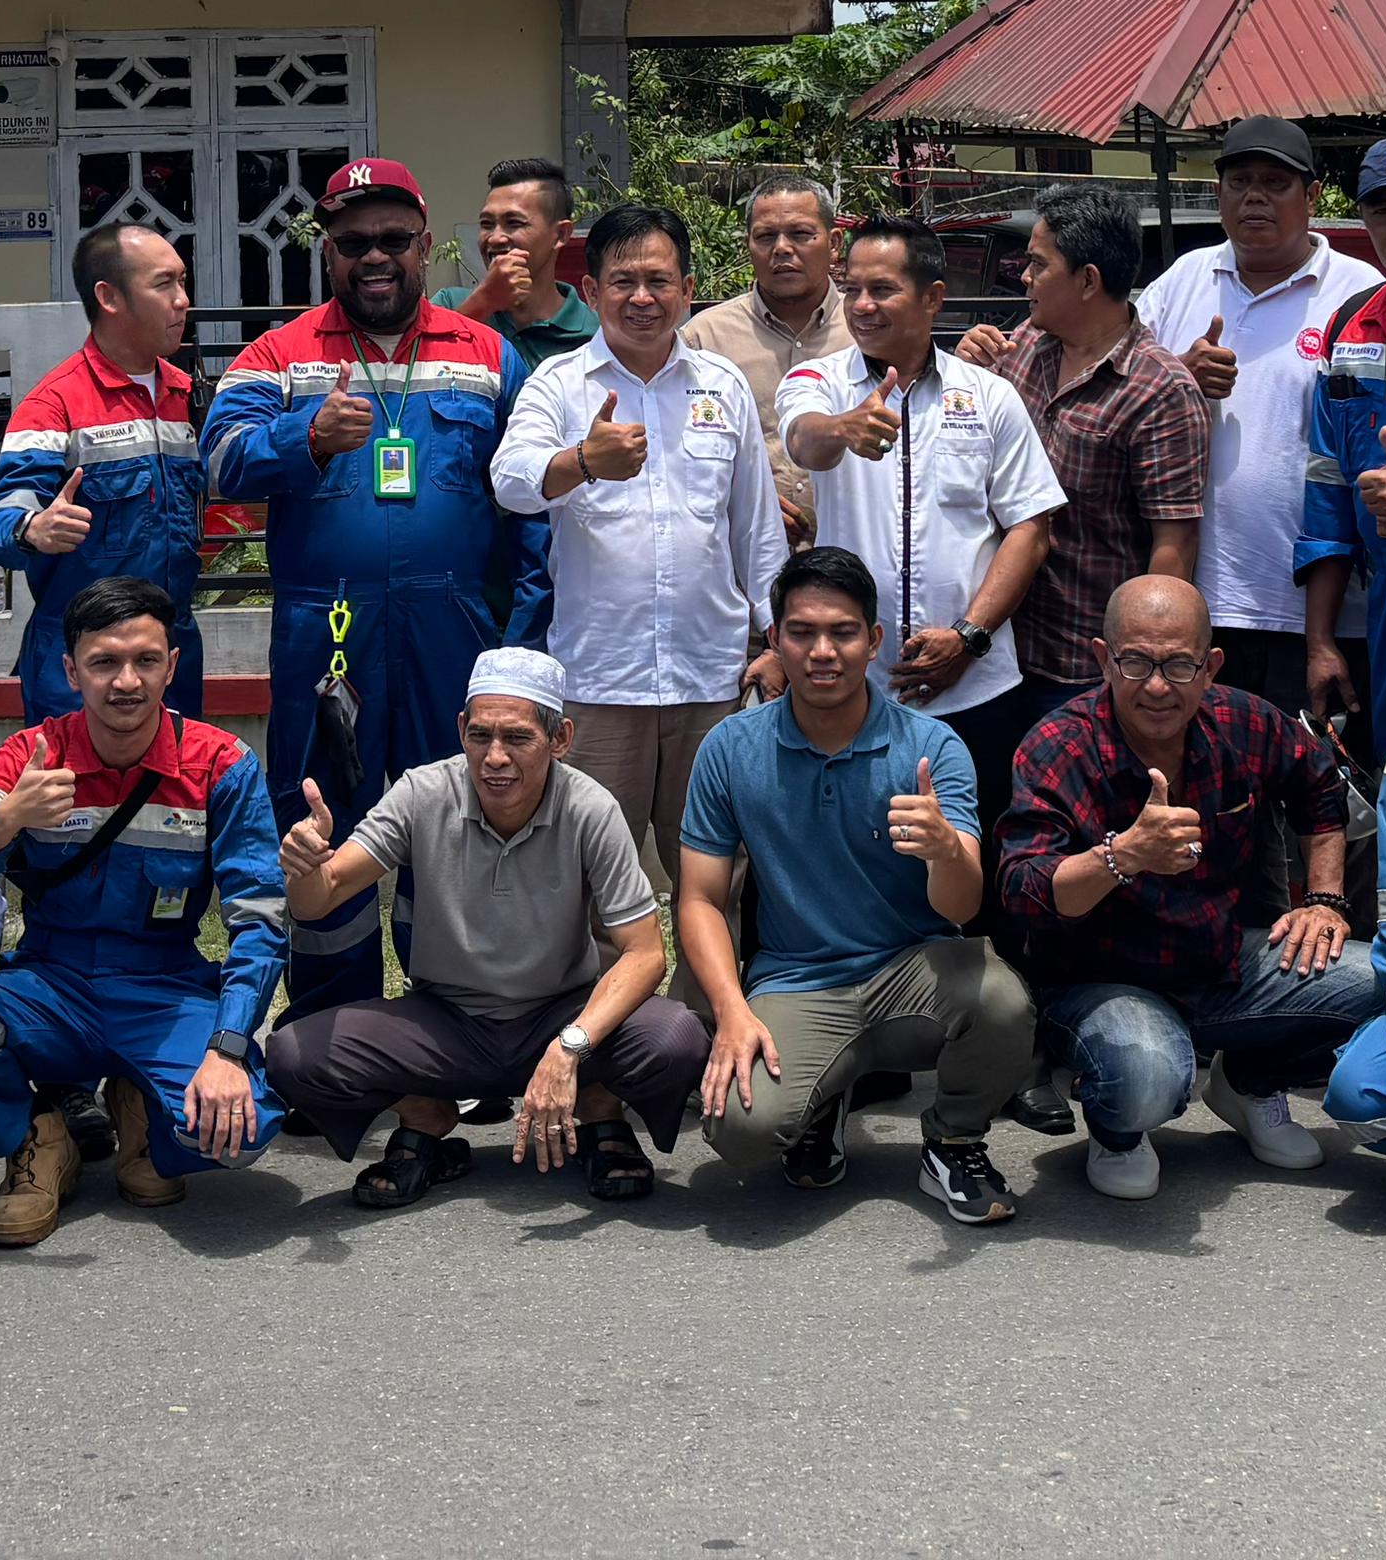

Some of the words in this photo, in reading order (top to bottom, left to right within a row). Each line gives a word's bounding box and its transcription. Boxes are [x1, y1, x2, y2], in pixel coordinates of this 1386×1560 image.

[35, 116, 50, 127] INI
[30, 127, 50, 135] CCTV
[27, 211, 48, 229] 89
